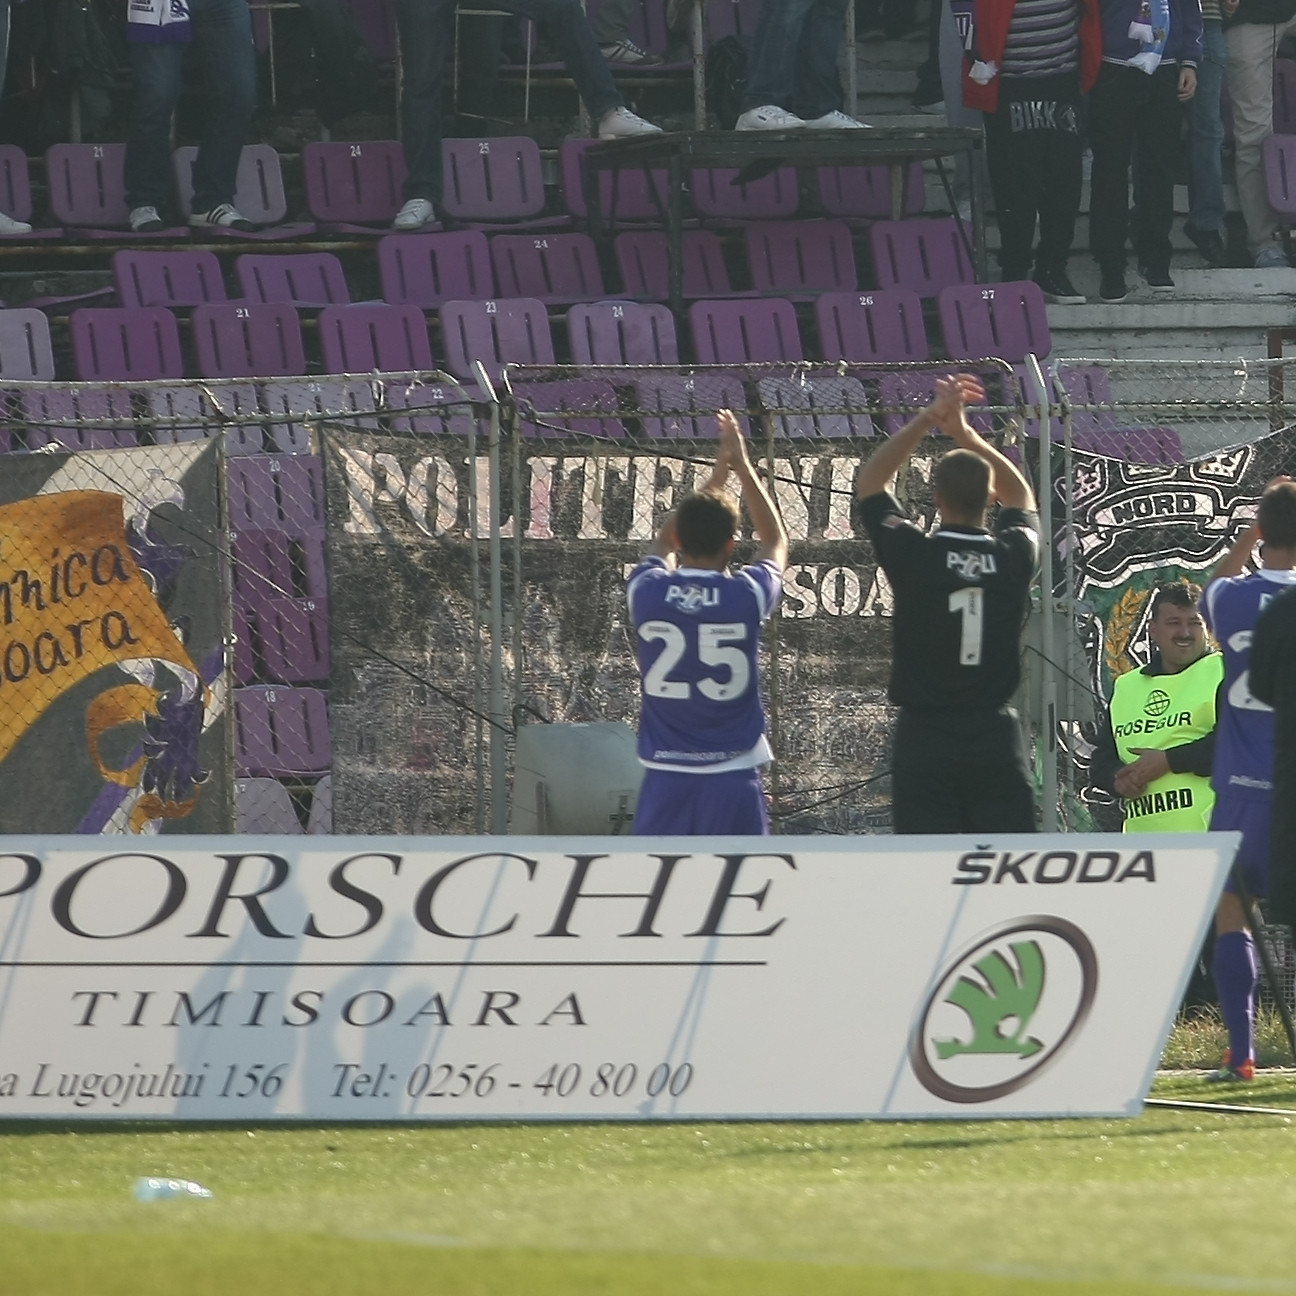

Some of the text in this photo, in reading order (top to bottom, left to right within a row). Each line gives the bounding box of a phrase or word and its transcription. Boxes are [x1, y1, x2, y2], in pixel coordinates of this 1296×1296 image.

[478, 142, 490, 154] 25
[235, 308, 250, 318] 21
[859, 296, 874, 306] 26
[1111, 491, 1197, 525] NORD
[947, 587, 984, 666] 1
[637, 619, 751, 702] 25
[951, 844, 1156, 885] ŠKODA
[70, 989, 590, 1028] TIMISOARA
[26, 1061, 210, 1108] Lugojului
[217, 1061, 290, 1099] 156
[330, 1061, 398, 1099] Tel:
[405, 1060, 502, 1099] 0256
[532, 1060, 583, 1099] 40
[588, 1060, 640, 1099] 80
[645, 1060, 697, 1099] 00
